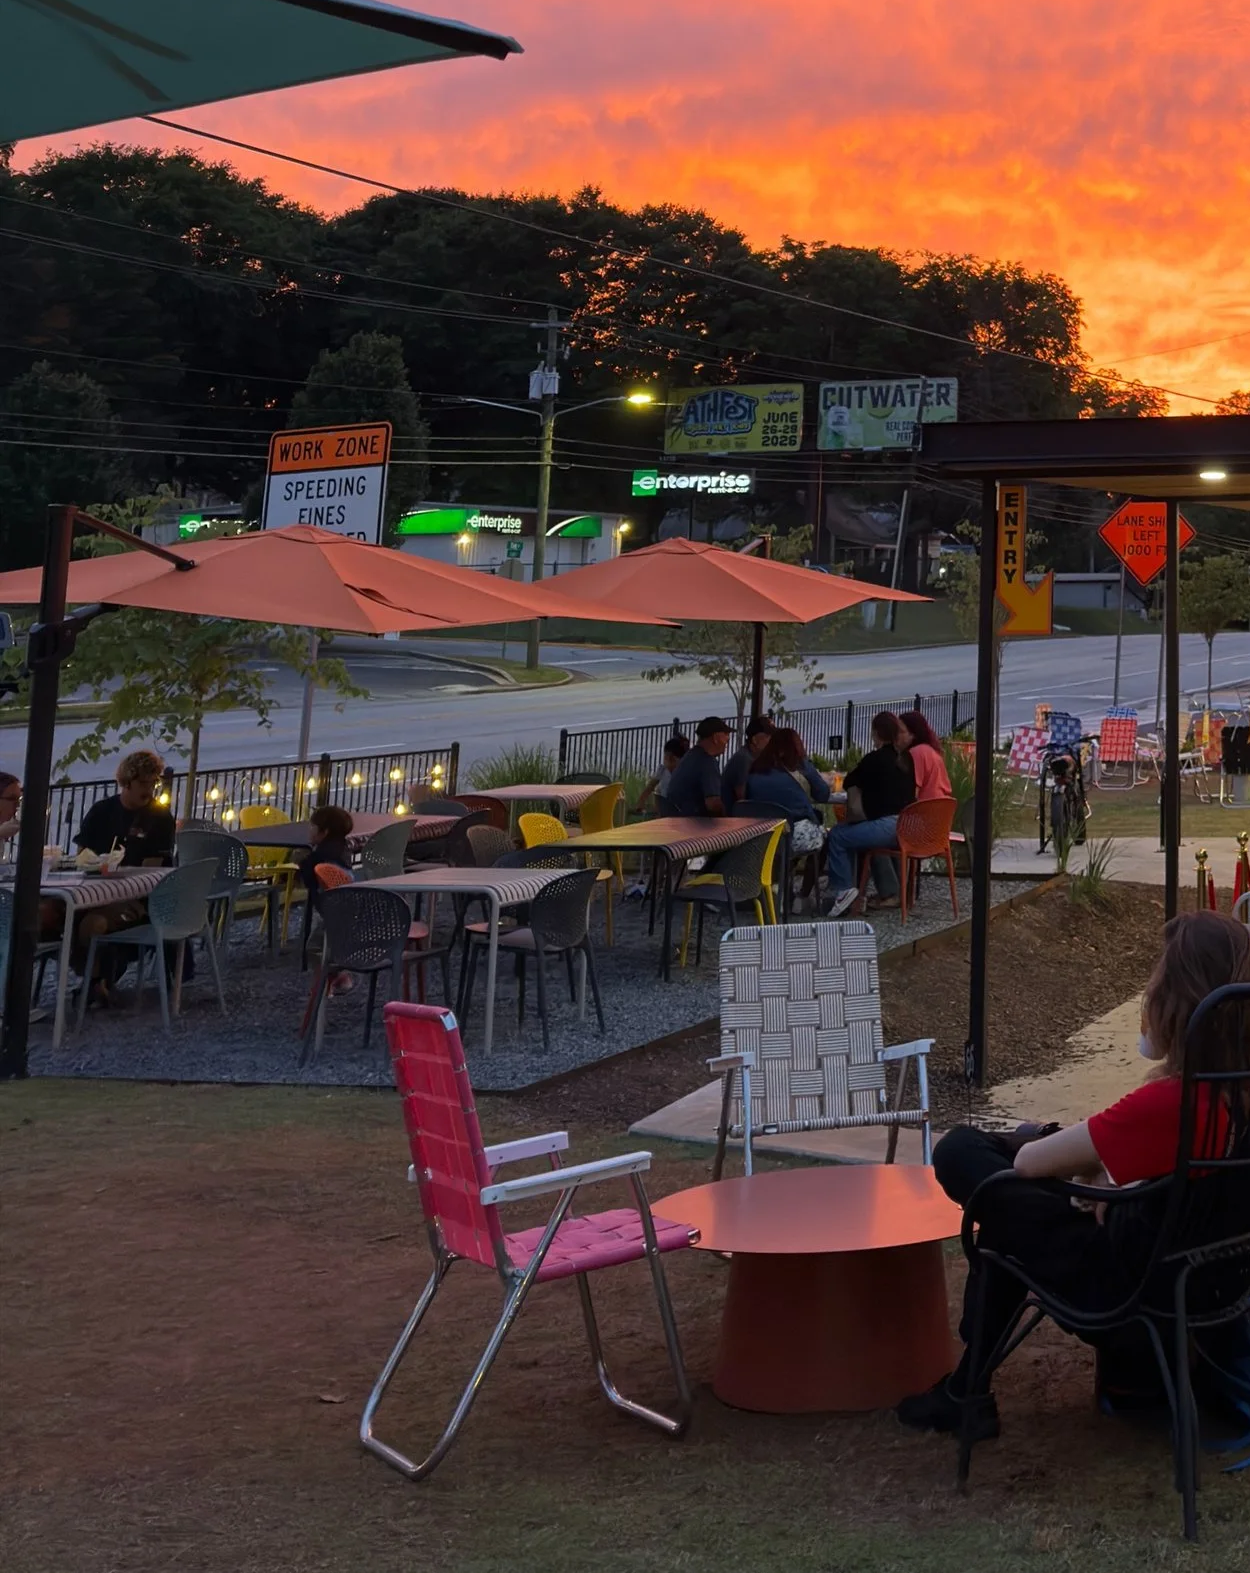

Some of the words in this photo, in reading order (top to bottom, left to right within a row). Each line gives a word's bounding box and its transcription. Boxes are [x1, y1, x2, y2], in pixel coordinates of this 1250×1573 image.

[822, 383, 951, 410] CUTWATER
[763, 411, 798, 424] JUNE
[280, 439, 324, 462] WORK
[335, 435, 380, 457] ZONE
[761, 435, 797, 447] 2026
[283, 476, 367, 501] SPEEDING
[638, 471, 751, 492] enterprise
[298, 505, 346, 526] FINES
[469, 514, 522, 532] enterprise
[1117, 516, 1144, 526] LANE
[1004, 492, 1020, 584] ENTRY
[1133, 530, 1160, 541] LEFT
[1123, 544, 1151, 557] 1000
